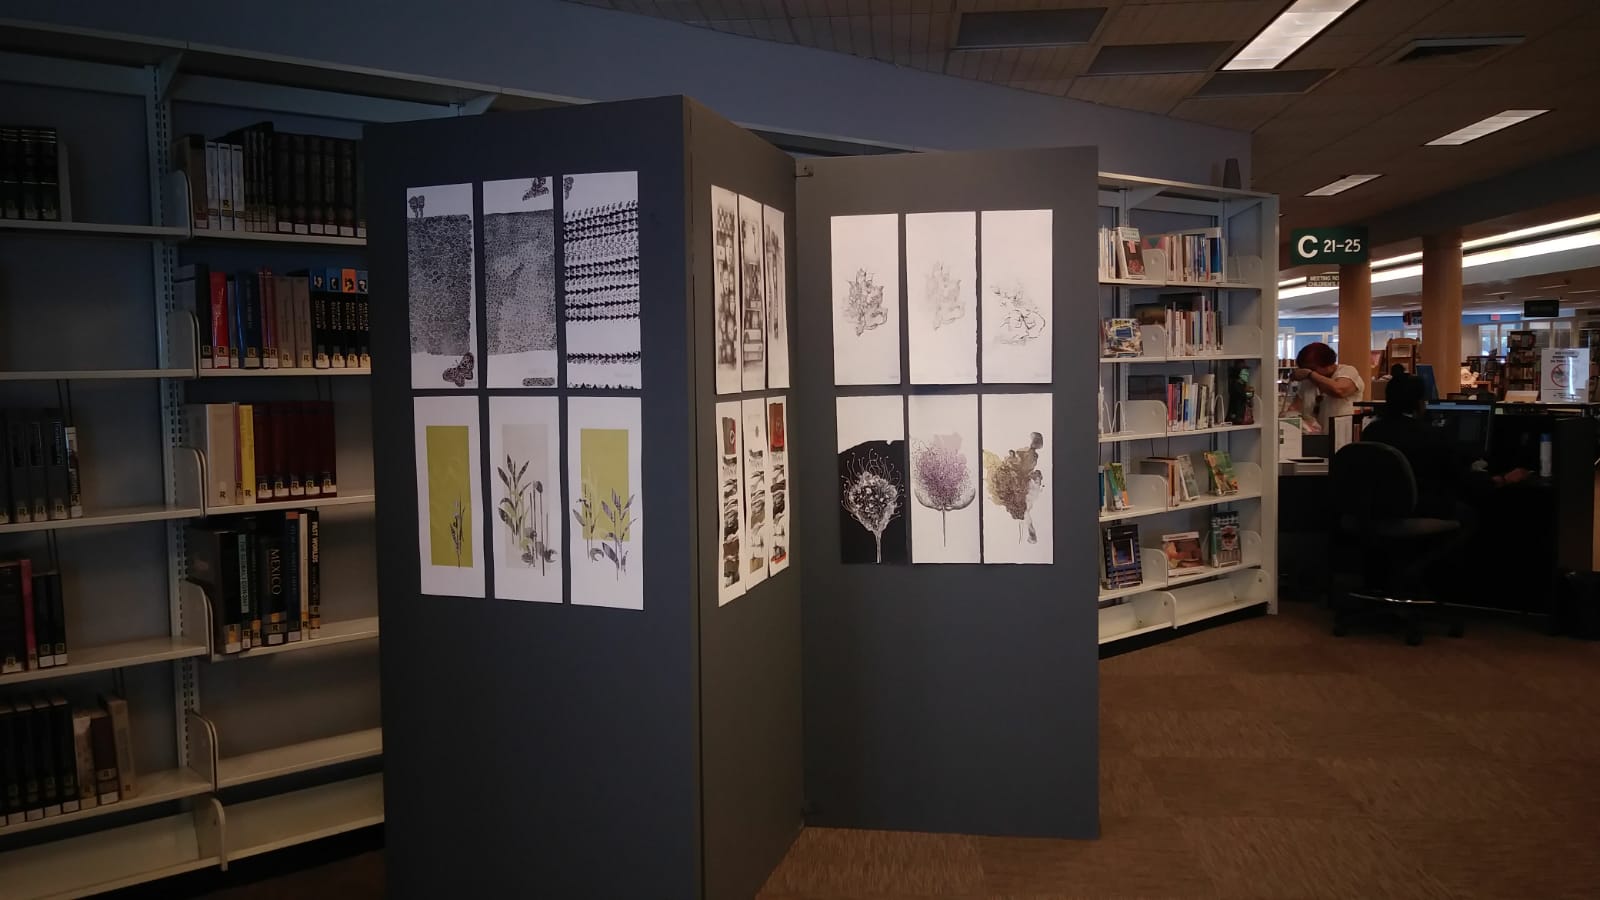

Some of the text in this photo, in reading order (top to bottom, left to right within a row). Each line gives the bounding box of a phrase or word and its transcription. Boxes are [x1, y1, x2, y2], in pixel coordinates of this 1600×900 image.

[1297, 235, 1361, 258] C 21-25
[271, 549, 282, 595] MEXICO
